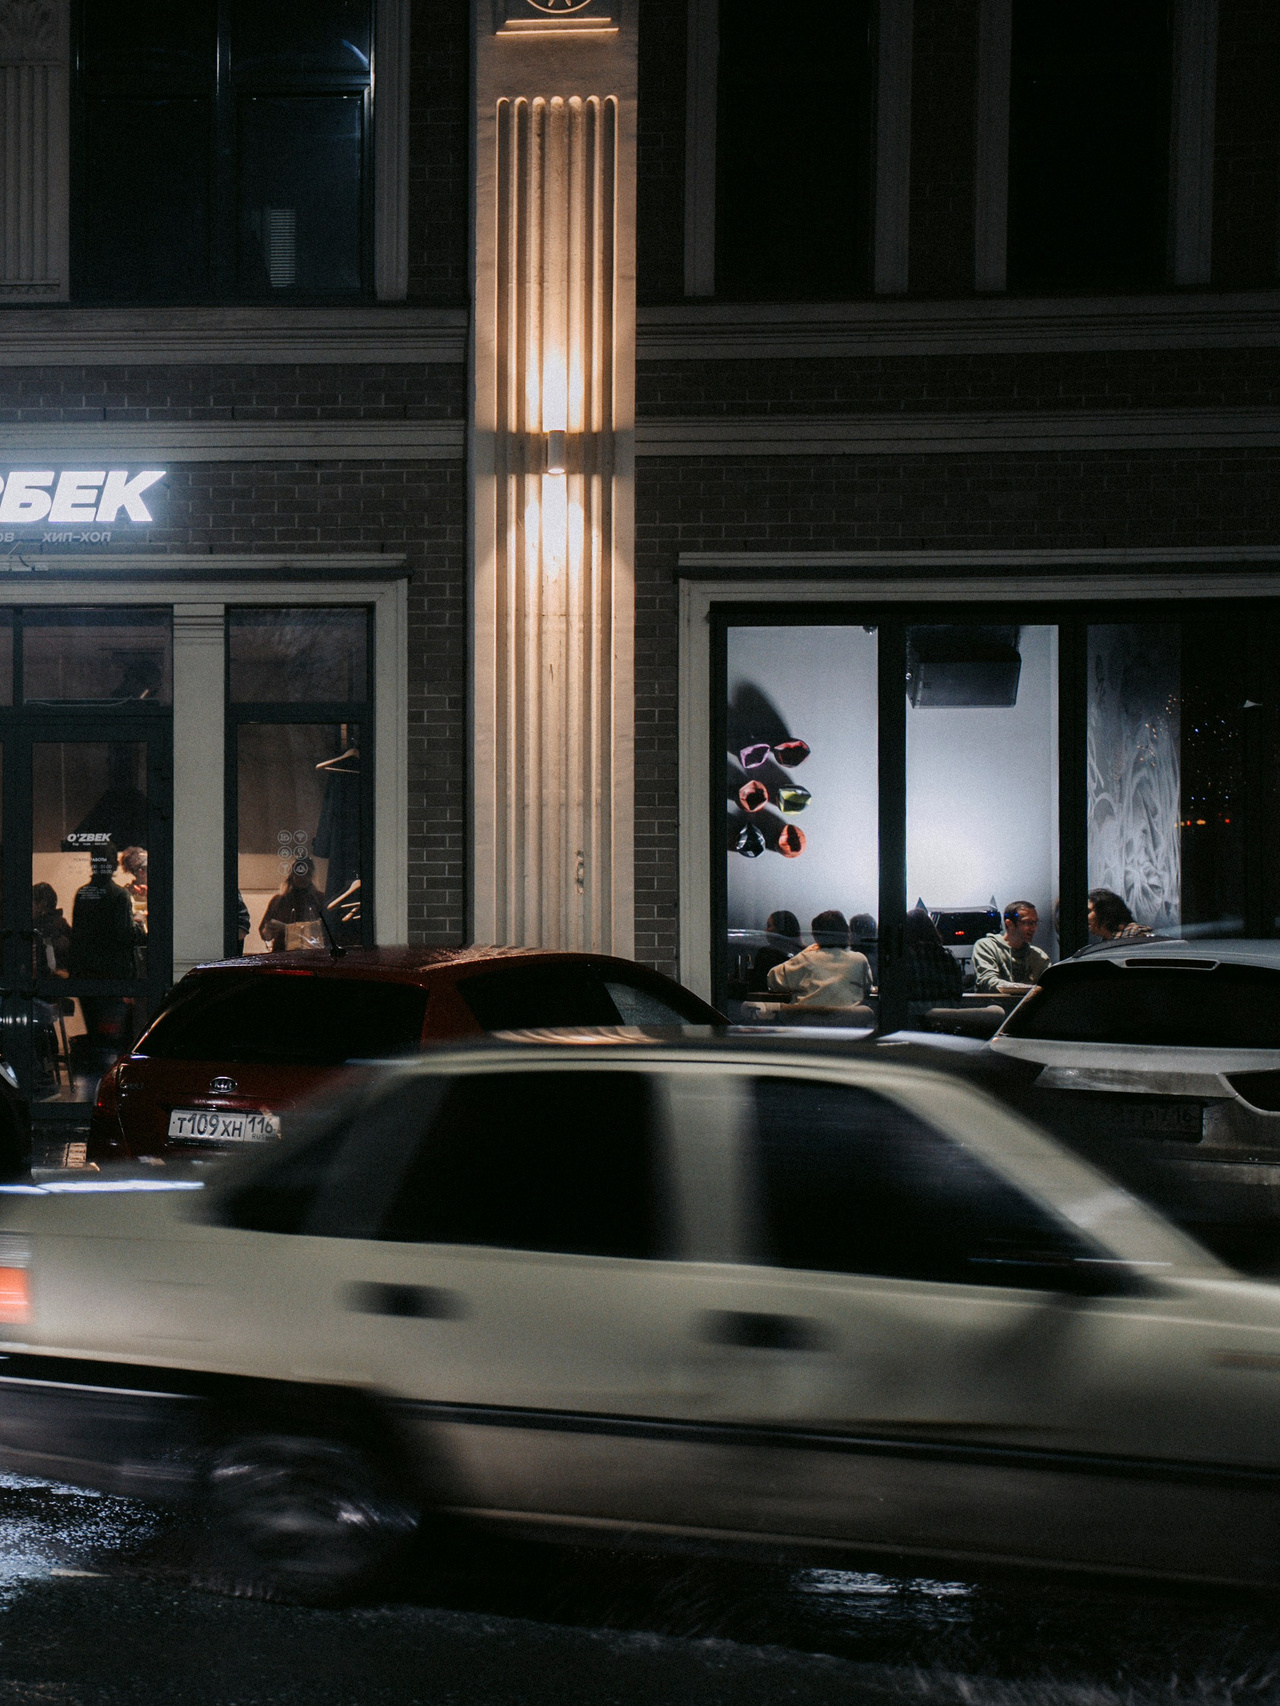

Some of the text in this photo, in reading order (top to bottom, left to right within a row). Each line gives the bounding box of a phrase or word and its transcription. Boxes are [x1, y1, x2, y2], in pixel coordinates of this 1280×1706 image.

[42, 530, 111, 543] хип-хоп
[67, 833, 112, 843] O'ZBEK
[177, 1113, 273, 1138] Т109ХН 116
